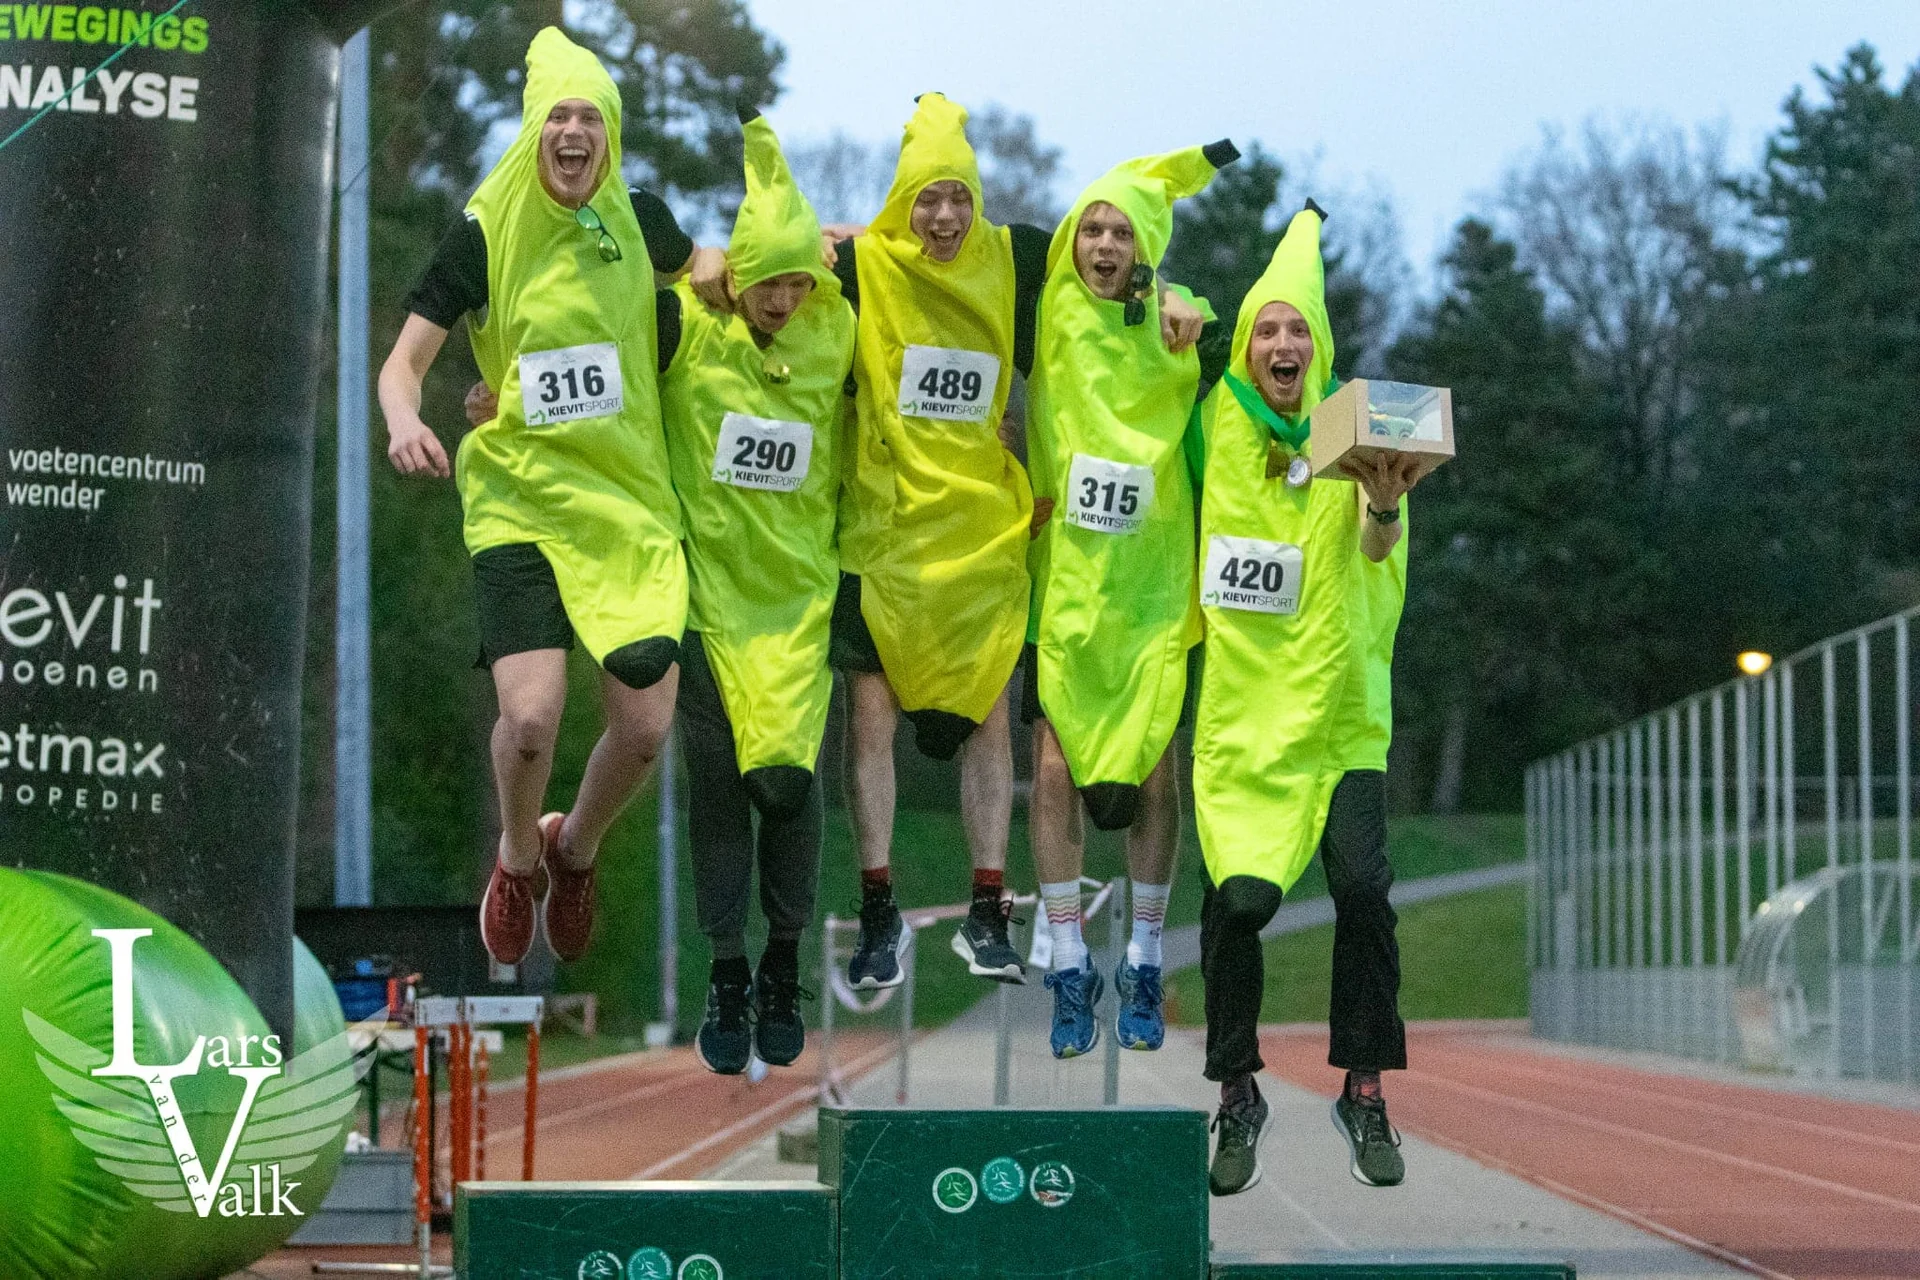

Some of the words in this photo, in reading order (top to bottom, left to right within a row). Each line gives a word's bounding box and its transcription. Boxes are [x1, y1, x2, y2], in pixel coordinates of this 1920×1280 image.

[0, 65, 200, 122] NALYSE
[538, 365, 606, 403] 316
[918, 367, 983, 402] 489
[547, 397, 620, 417] KIEVITSPORT
[921, 401, 988, 416] KIEVITSPORT
[8, 447, 206, 485] voetencentrum
[732, 435, 797, 473] 290
[6, 480, 106, 511] wender
[1079, 476, 1140, 516] 315
[1219, 556, 1284, 593] 420
[0, 573, 163, 655] evit
[1222, 591, 1294, 608] KIEVITSPORT
[0, 659, 158, 693] oenen
[0, 782, 164, 814] OPEDIE
